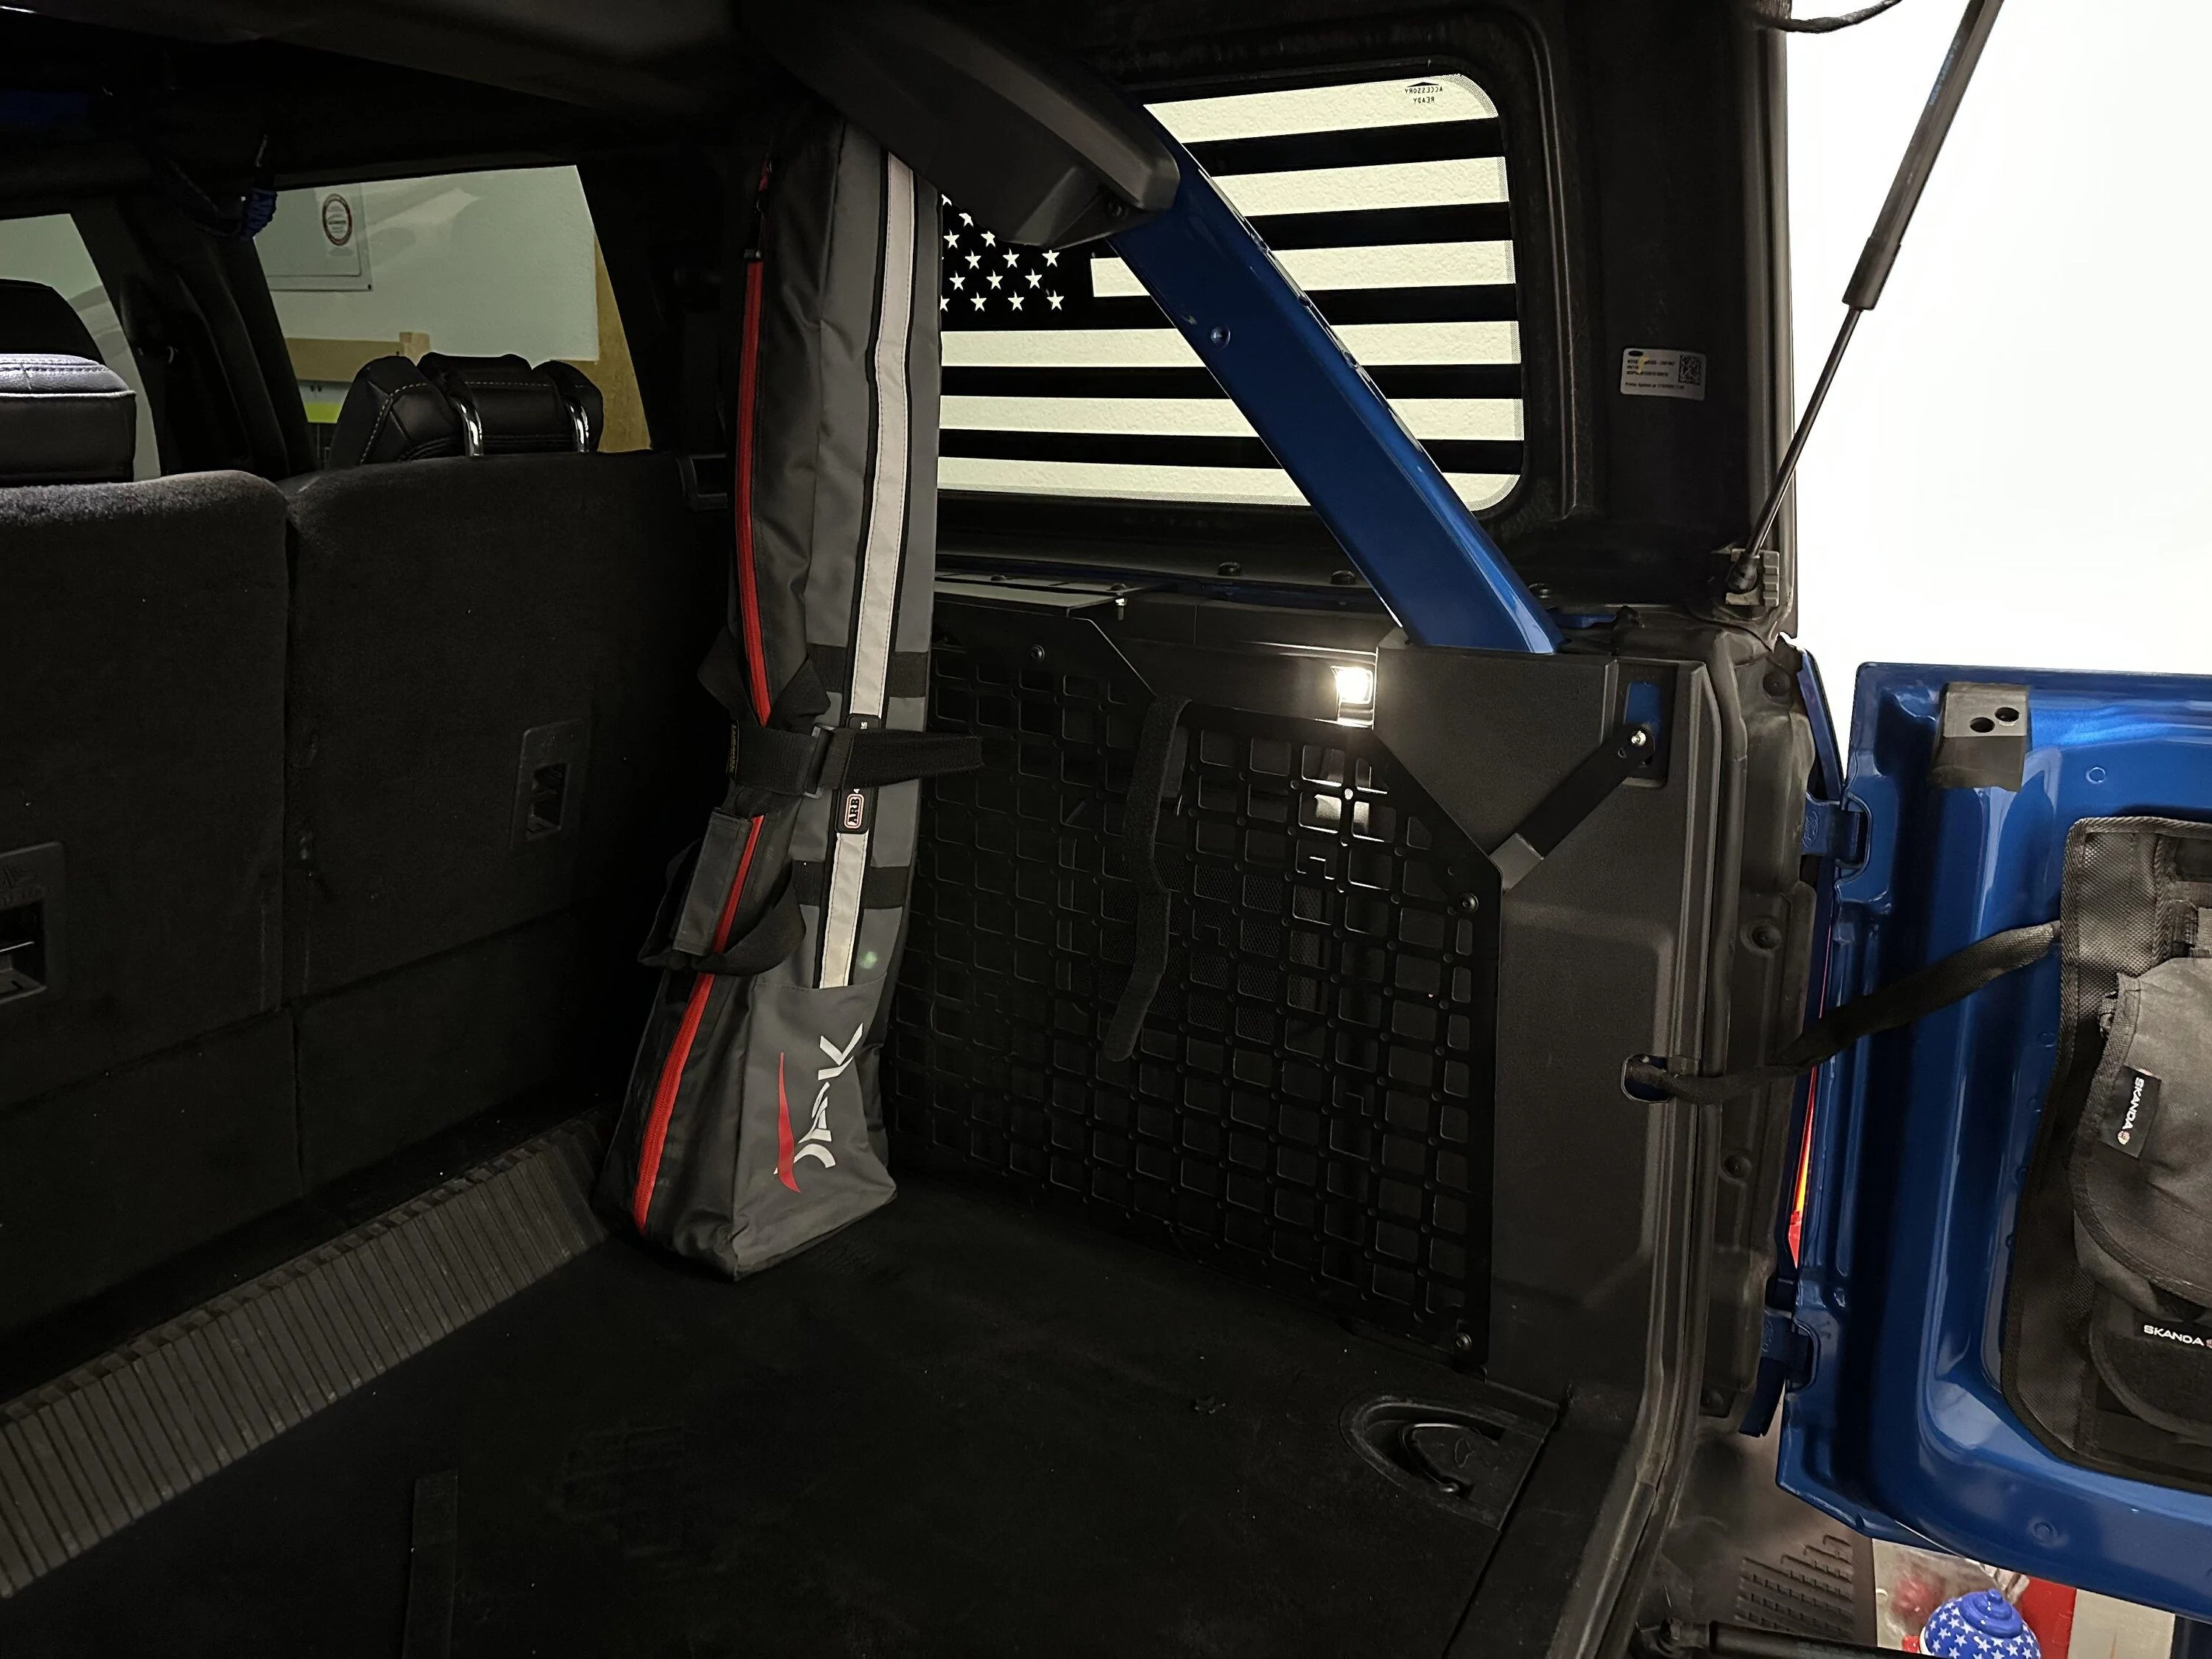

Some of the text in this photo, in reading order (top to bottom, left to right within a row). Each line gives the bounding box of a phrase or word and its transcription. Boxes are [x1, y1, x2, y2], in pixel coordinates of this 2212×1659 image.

[848, 797, 860, 824] ARB
[2122, 1077, 2145, 1130] SKANDA
[2143, 1324, 2205, 1346] SKANDA
